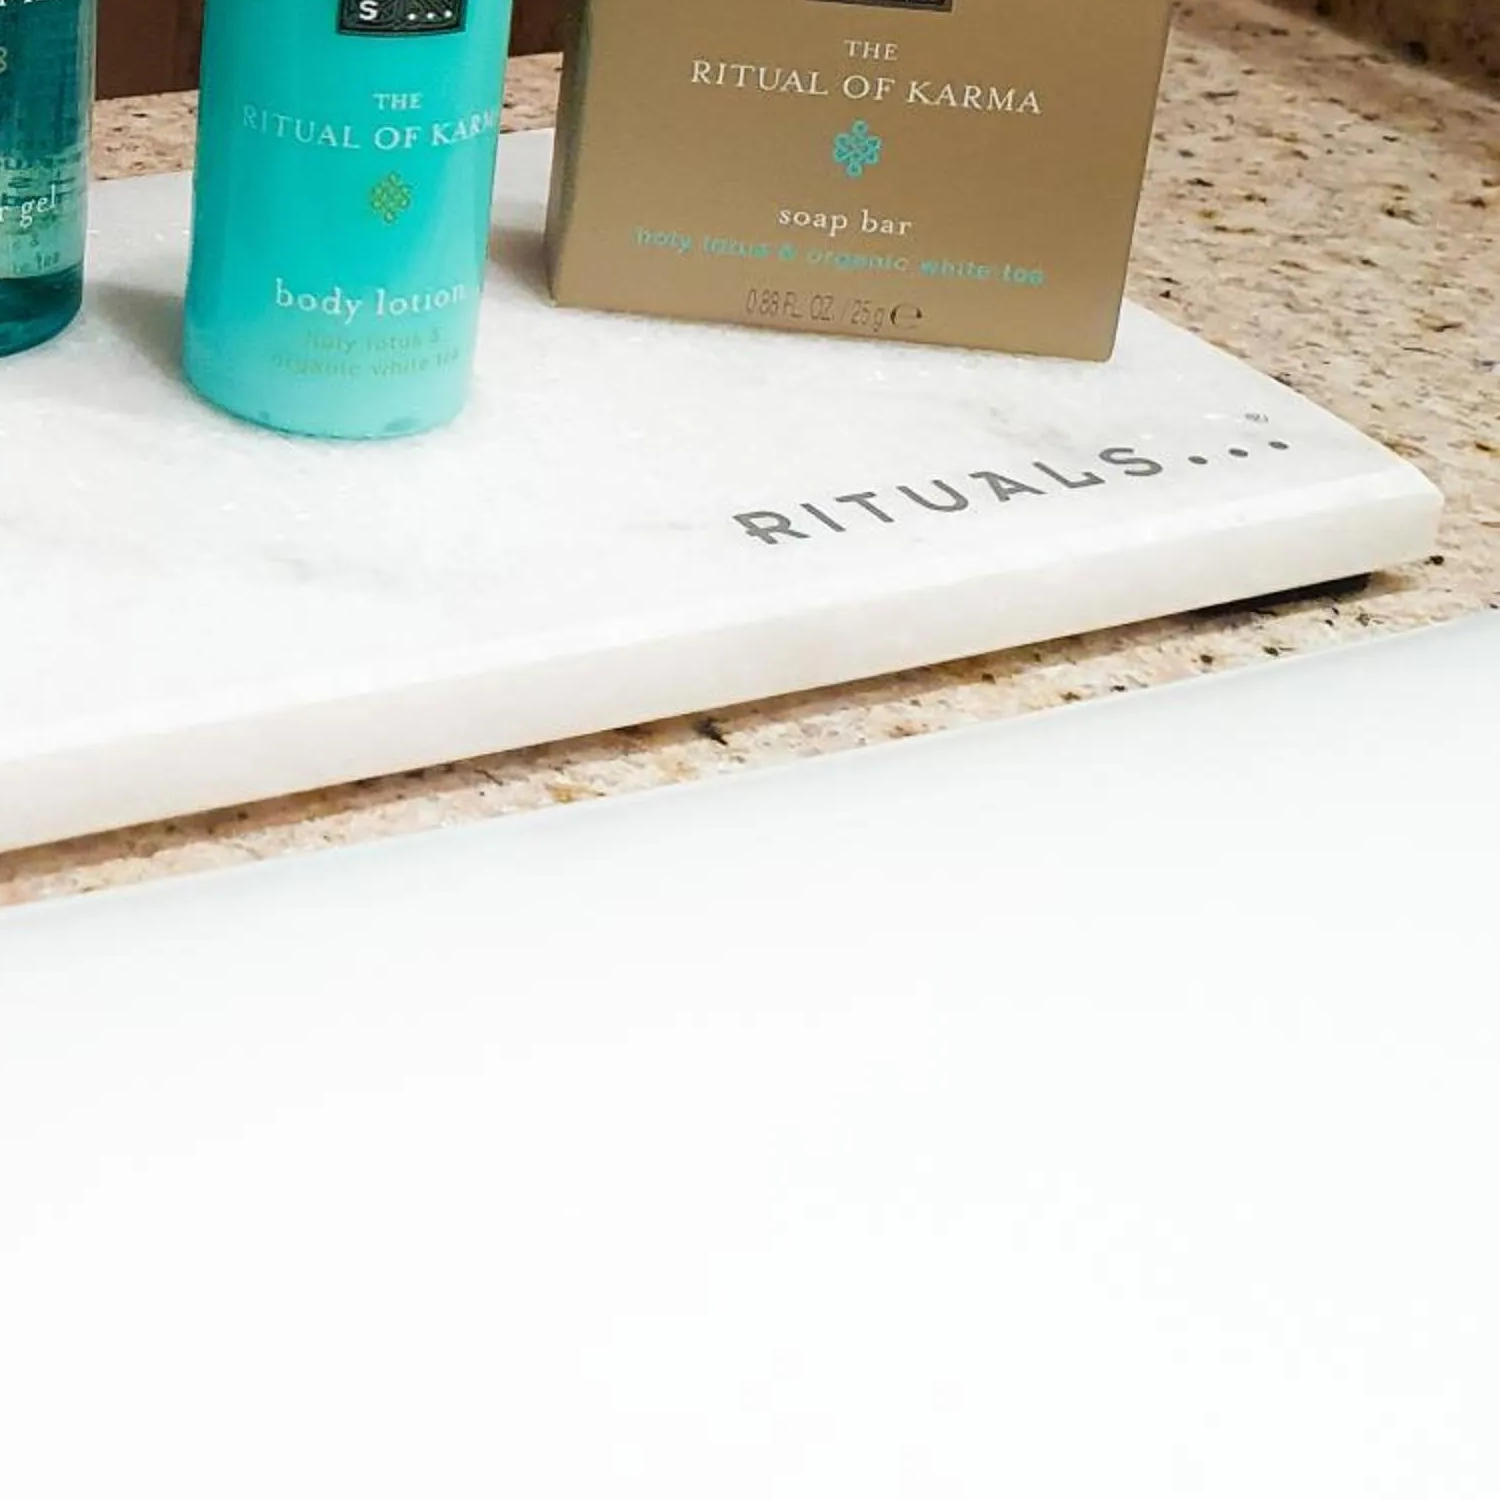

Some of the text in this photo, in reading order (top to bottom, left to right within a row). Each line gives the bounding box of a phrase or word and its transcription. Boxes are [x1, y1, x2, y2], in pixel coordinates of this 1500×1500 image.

[844, 40, 900, 61] THE
[372, 92, 423, 111] THE
[690, 58, 1043, 115] RITUAL OF KARMA
[242, 104, 362, 149] RITUAL
[373, 126, 422, 150] OF
[19, 184, 57, 228] gel
[776, 207, 912, 237] soap bar
[275, 277, 467, 325] body lotion
